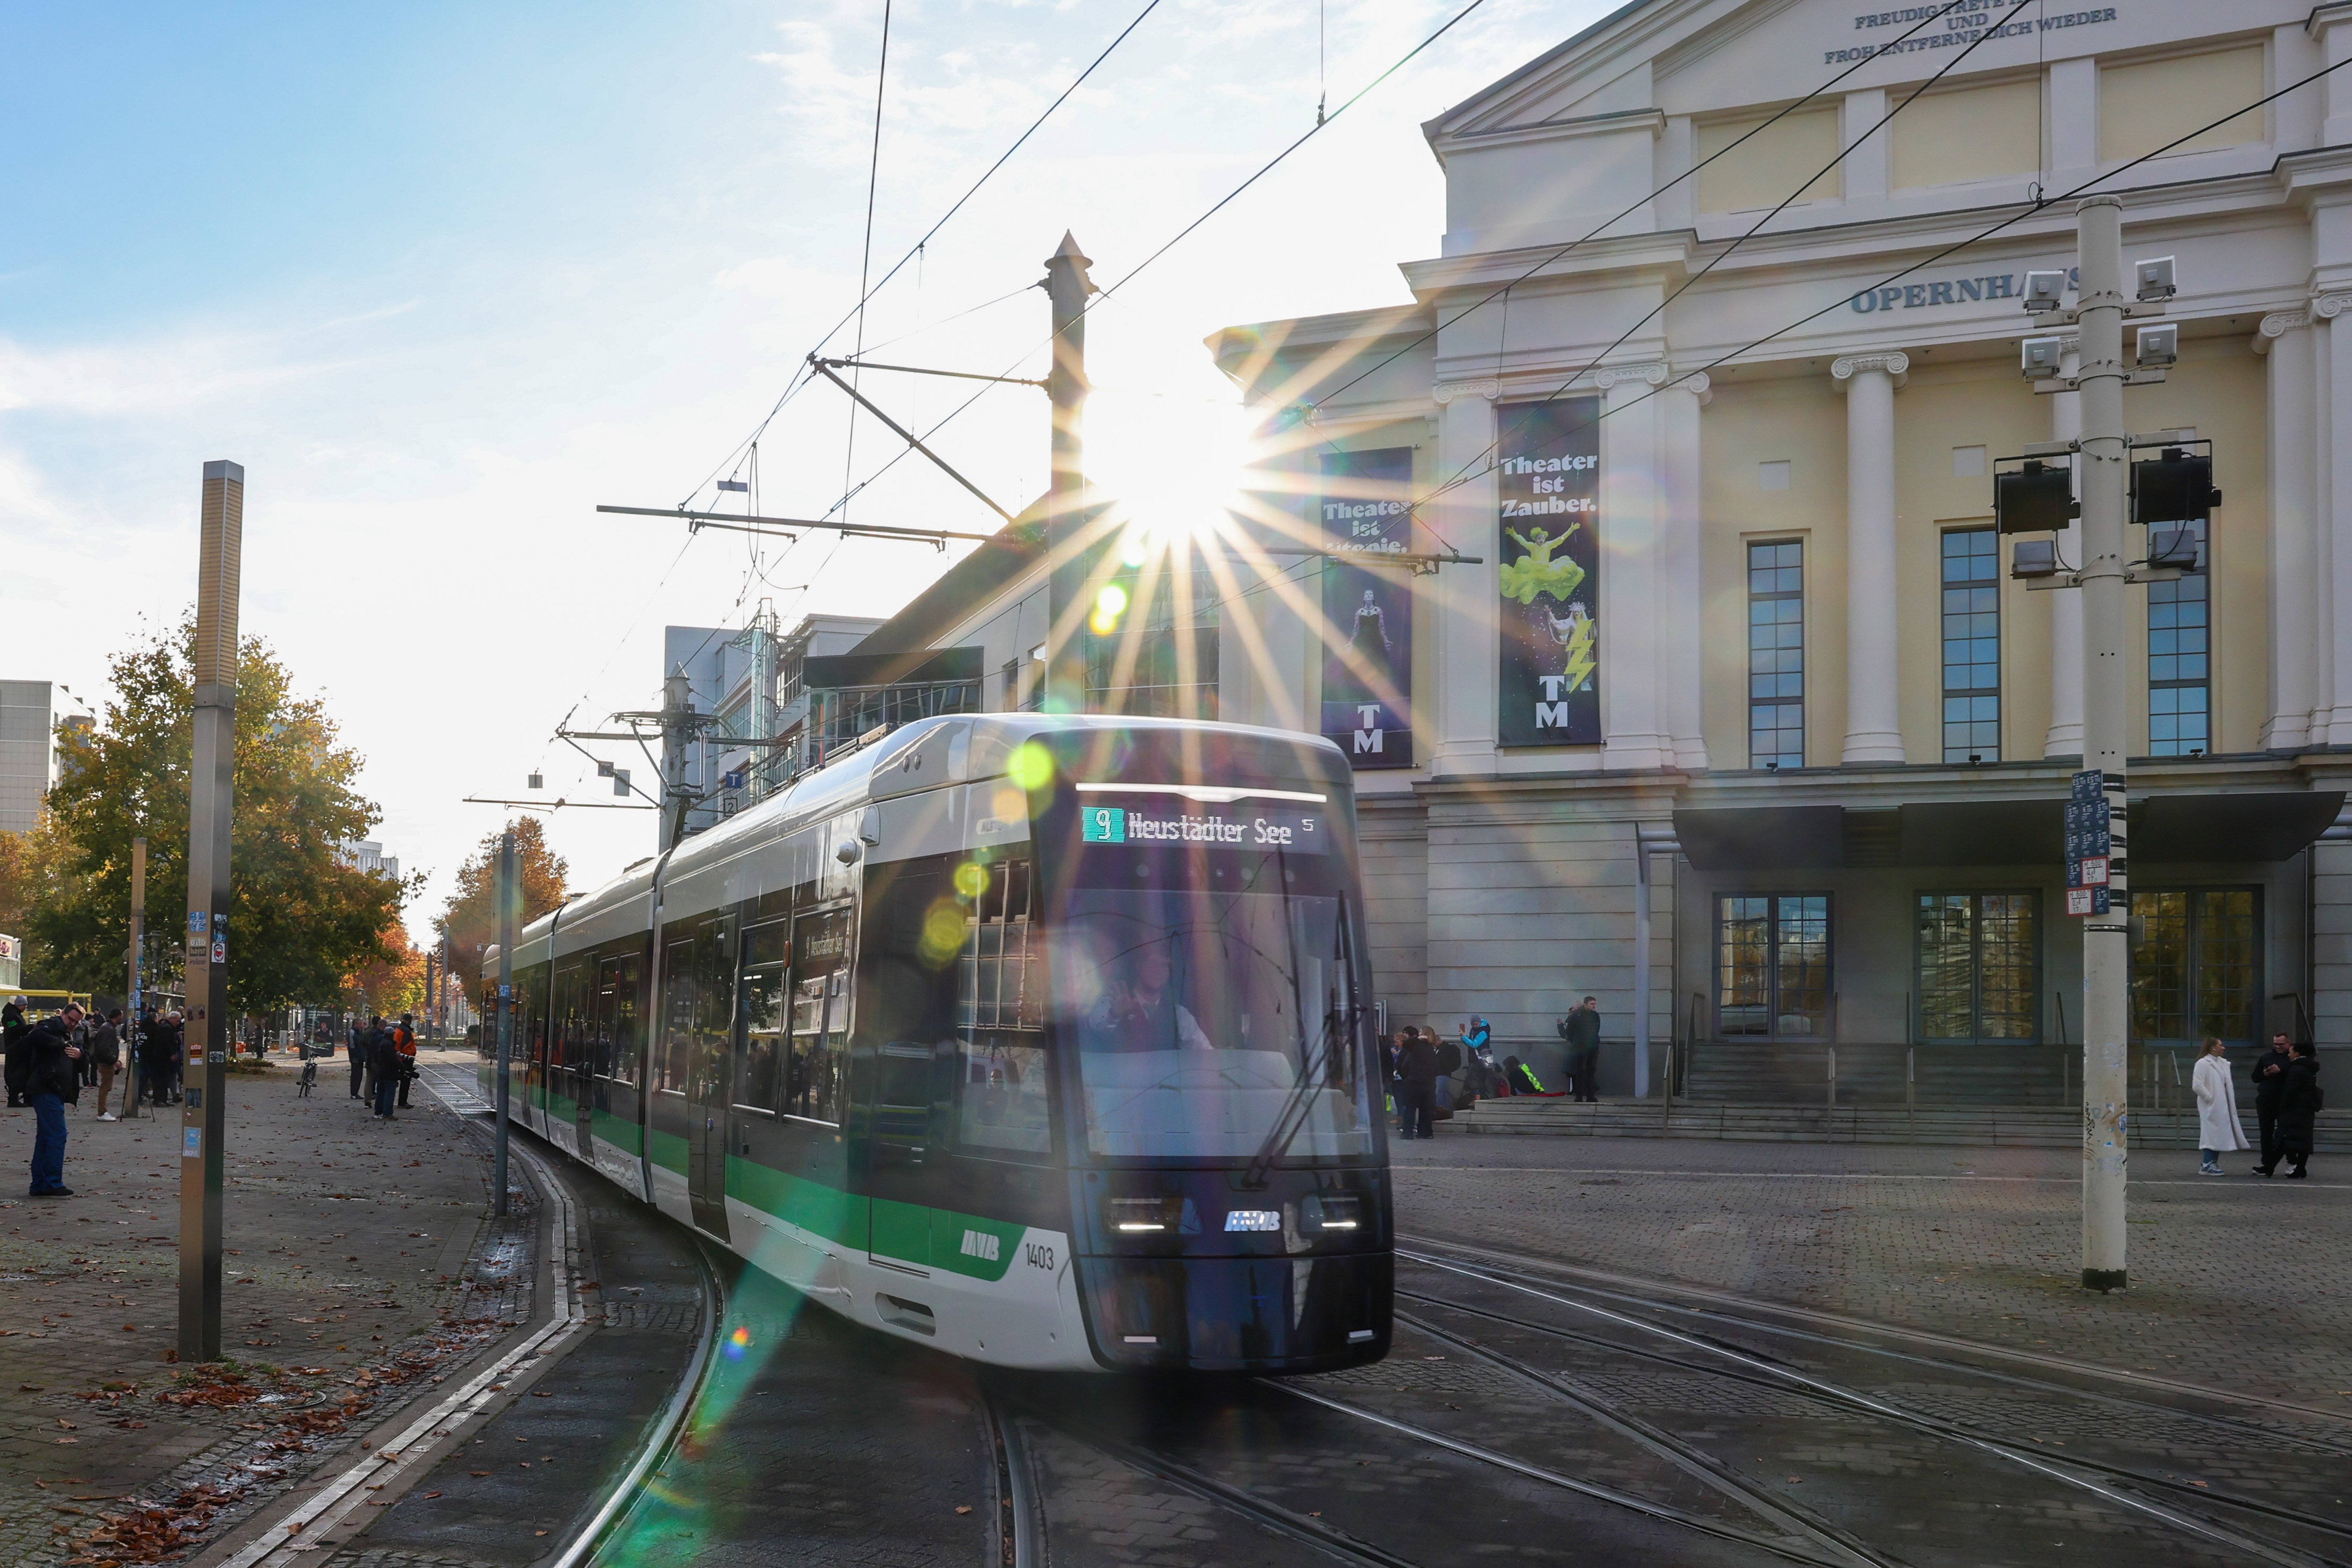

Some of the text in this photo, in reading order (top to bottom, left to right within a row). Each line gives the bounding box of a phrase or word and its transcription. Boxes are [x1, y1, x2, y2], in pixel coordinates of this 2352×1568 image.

[1855, 5, 1938, 29] FREUDIG
[1947, 13, 1988, 29] UND
[1825, 8, 2117, 64] FROH ENTFERNE DICH WIEDER
[1500, 454, 1597, 475] Theater
[1533, 476, 1564, 494] ist
[1323, 501, 1411, 520] Theater
[1501, 496, 1597, 517] Zauber.
[1352, 520, 1380, 537] ist
[729, 774, 739, 786] T
[728, 802, 734, 812] 2
[1096, 809, 1112, 840] 9
[1128, 813, 1248, 842] Neustädter
[1255, 818, 1292, 844] See
[1026, 1242, 1054, 1271] 1403
